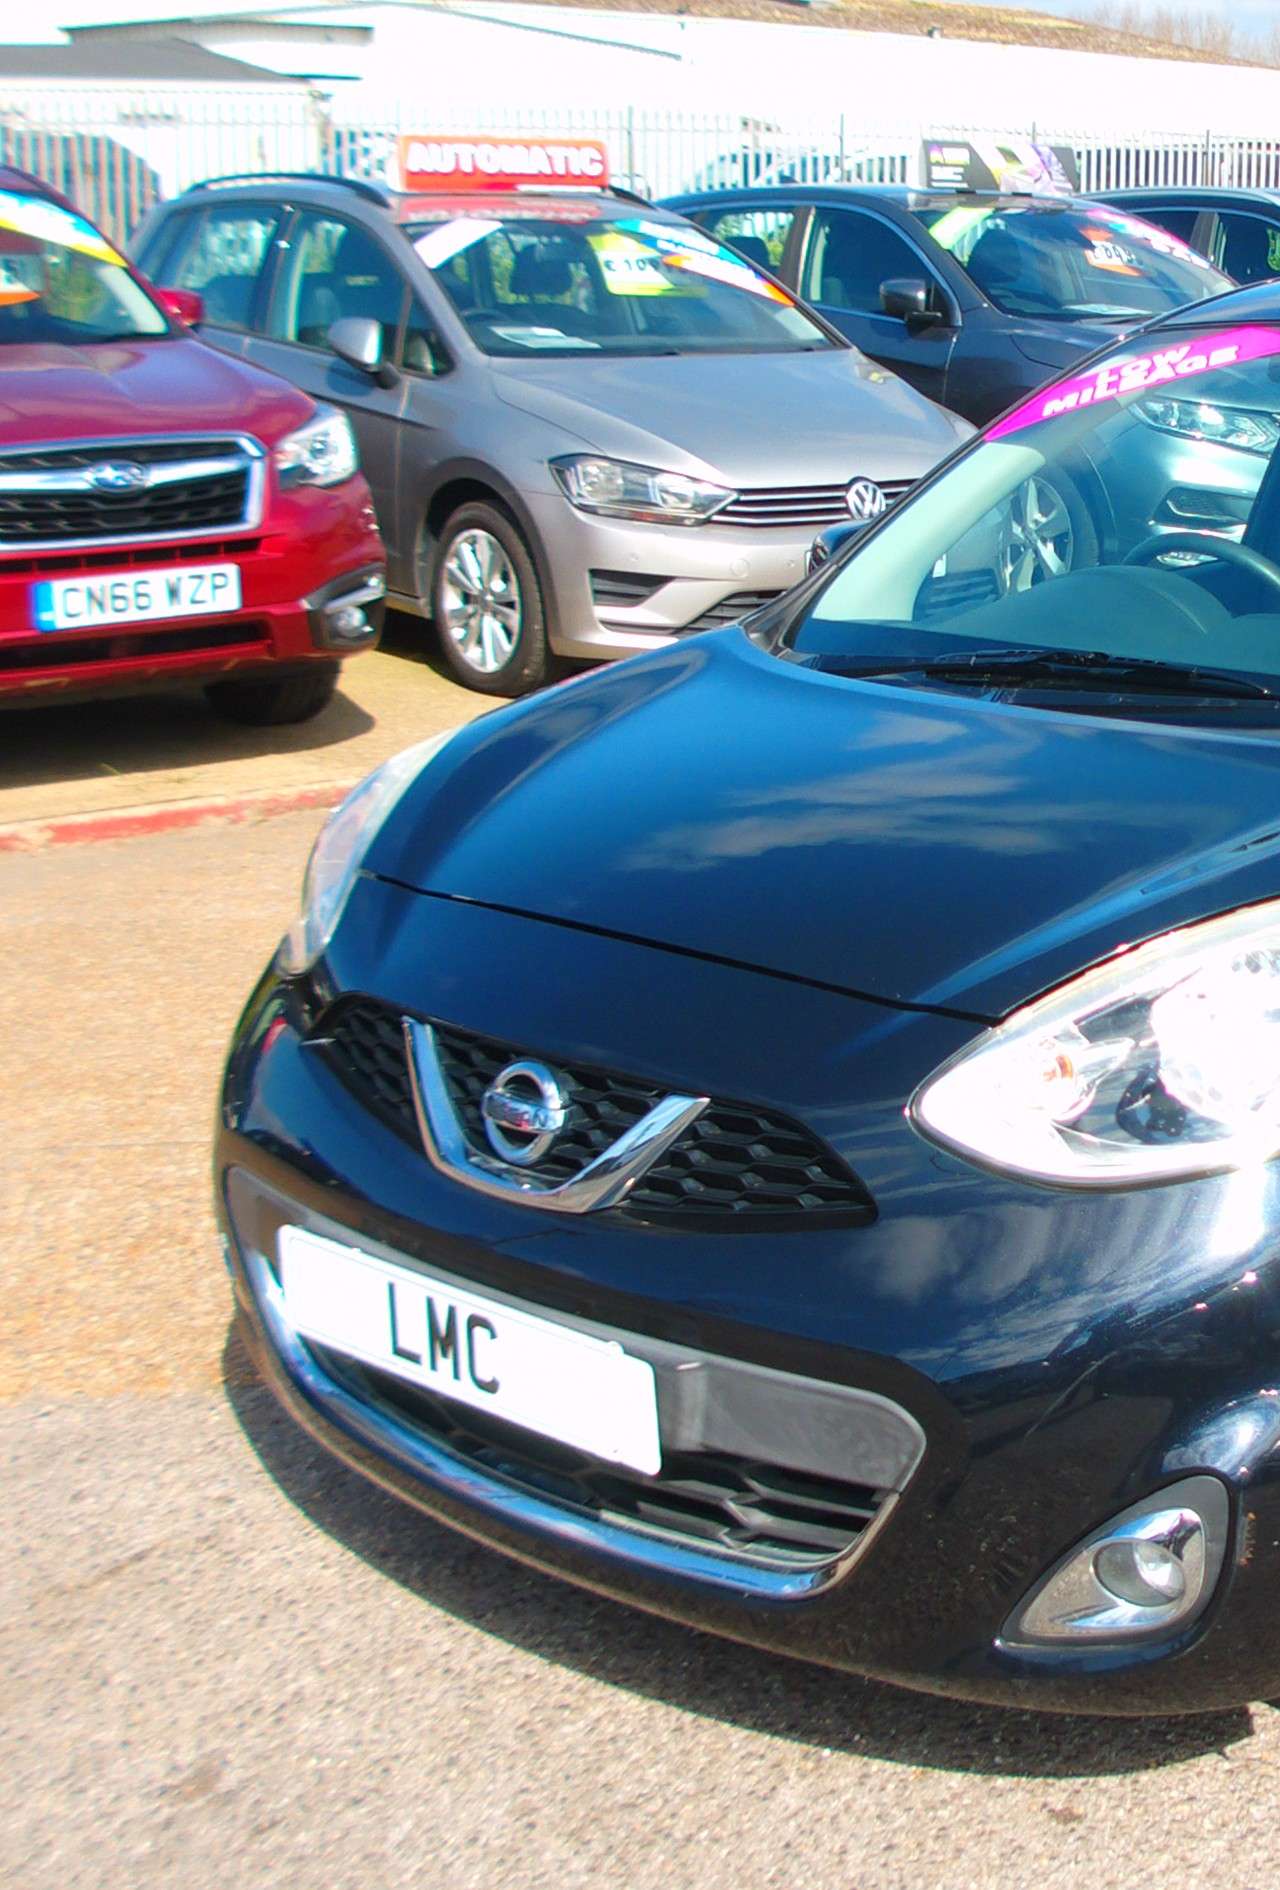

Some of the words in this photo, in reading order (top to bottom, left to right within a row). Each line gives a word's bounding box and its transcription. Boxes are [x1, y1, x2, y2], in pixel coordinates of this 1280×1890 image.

[405, 142, 605, 177] AUTOMATIC
[1041, 345, 1240, 417] MILEAGE
[1096, 345, 1192, 384] LOW
[62, 579, 152, 619] CN66
[165, 571, 229, 608] WZP
[387, 1280, 500, 1395] LMC
